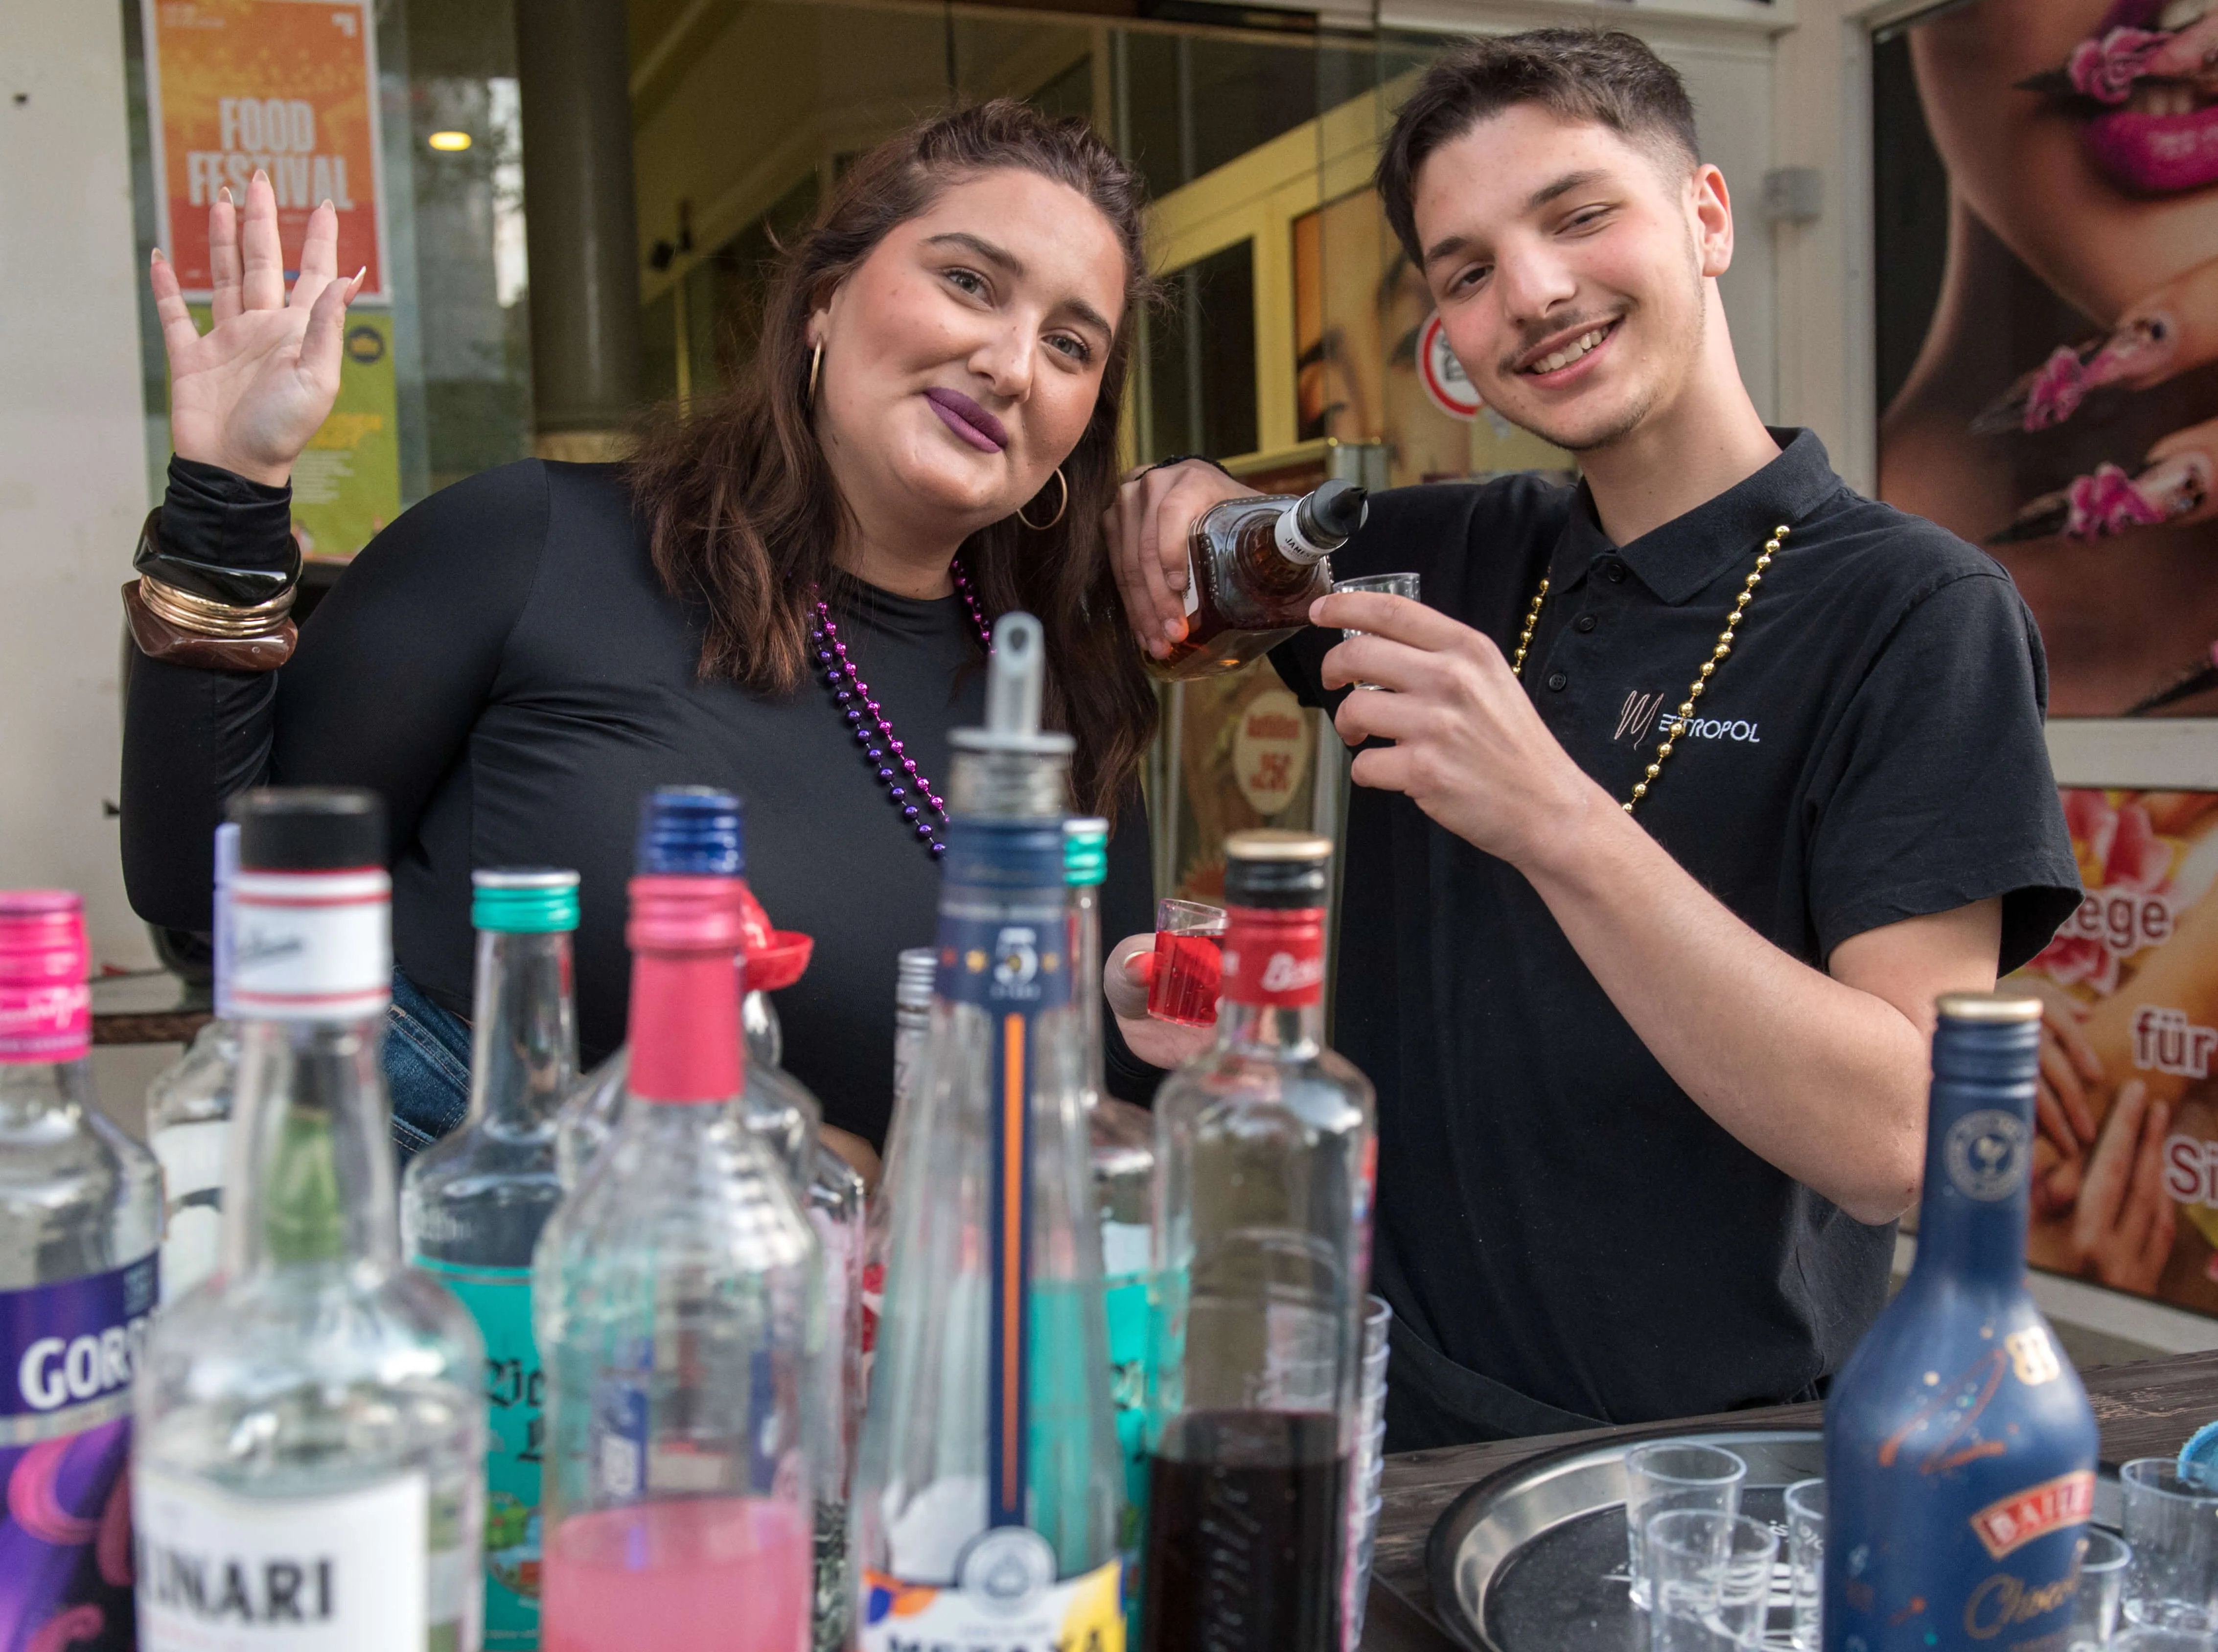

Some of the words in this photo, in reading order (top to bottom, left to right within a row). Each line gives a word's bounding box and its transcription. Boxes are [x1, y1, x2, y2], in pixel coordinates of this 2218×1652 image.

[218, 97, 316, 152] FOOD
[2064, 895, 2169, 950] ege
[2136, 1011, 2211, 1070] für
